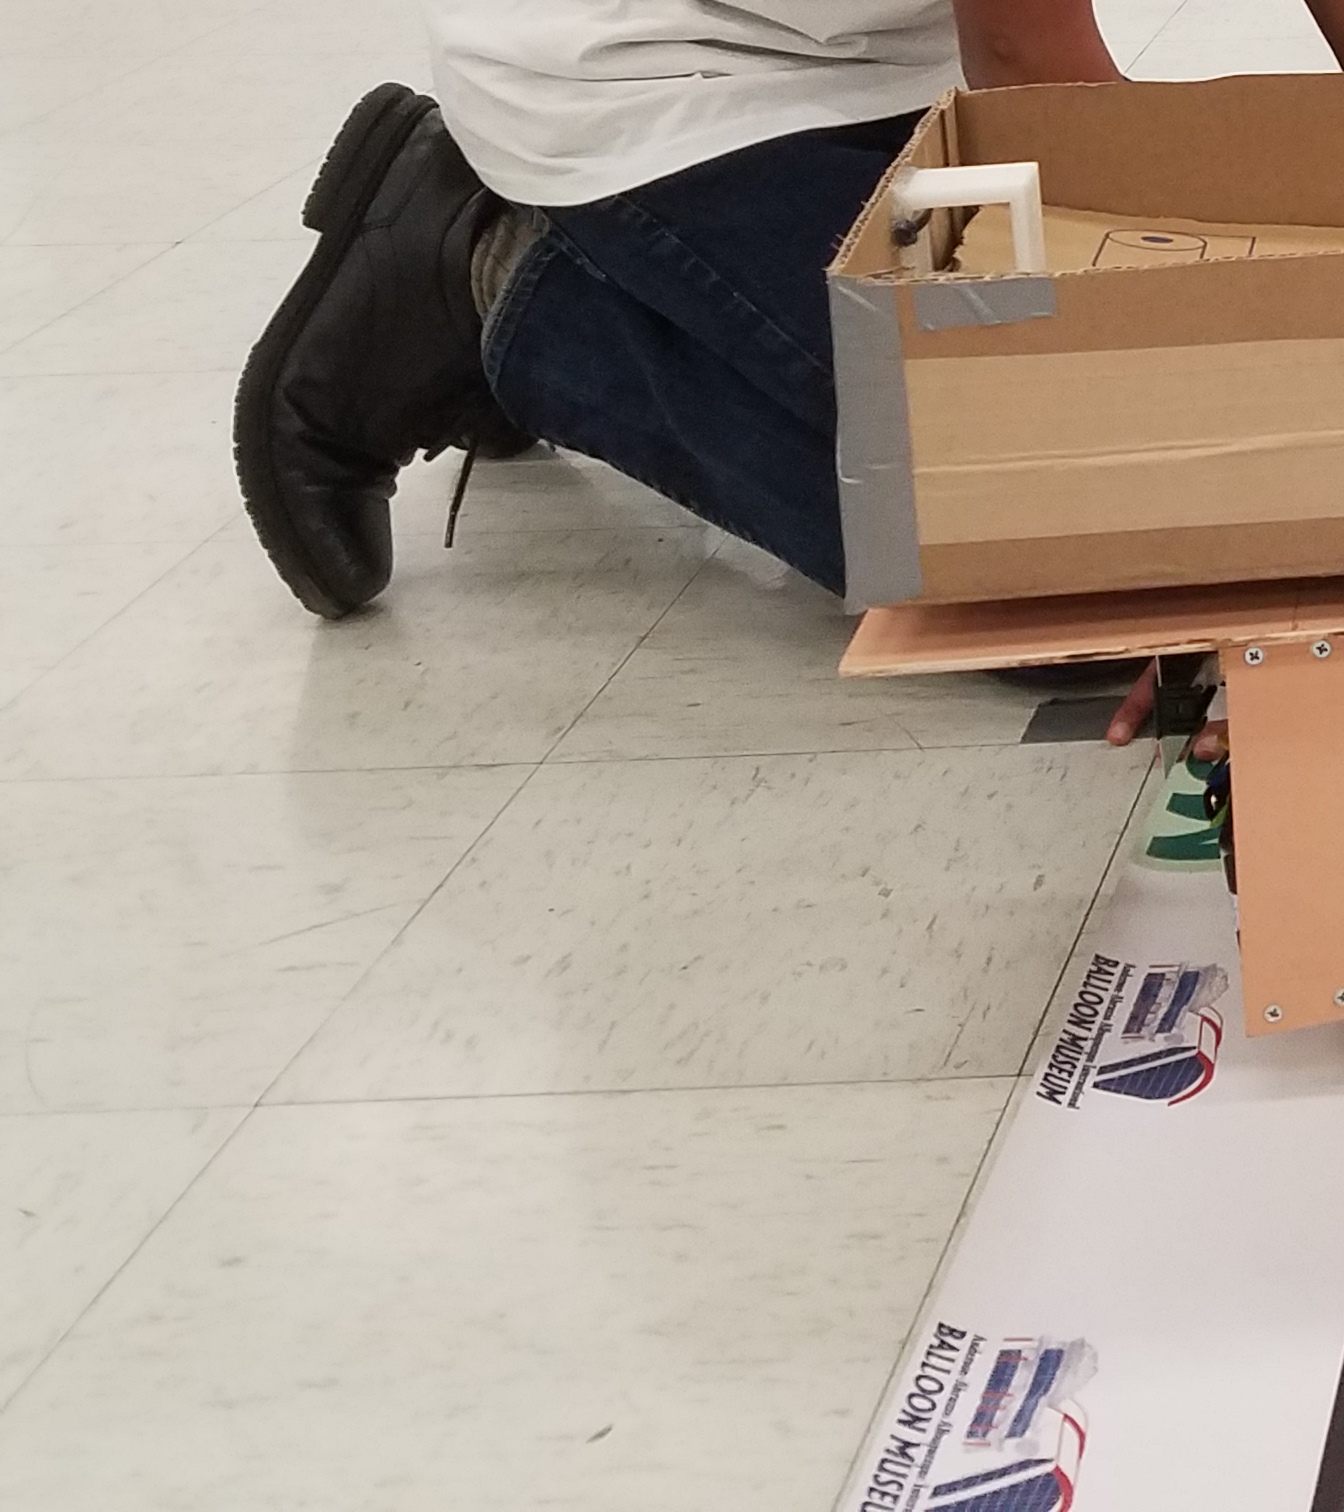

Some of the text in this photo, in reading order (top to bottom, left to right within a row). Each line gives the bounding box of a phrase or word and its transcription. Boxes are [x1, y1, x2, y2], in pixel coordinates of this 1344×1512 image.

[1067, 953, 1120, 1033] BALLOON
[1036, 1029, 1084, 1105] MUSEUM
[895, 1320, 968, 1433] BALLOON
